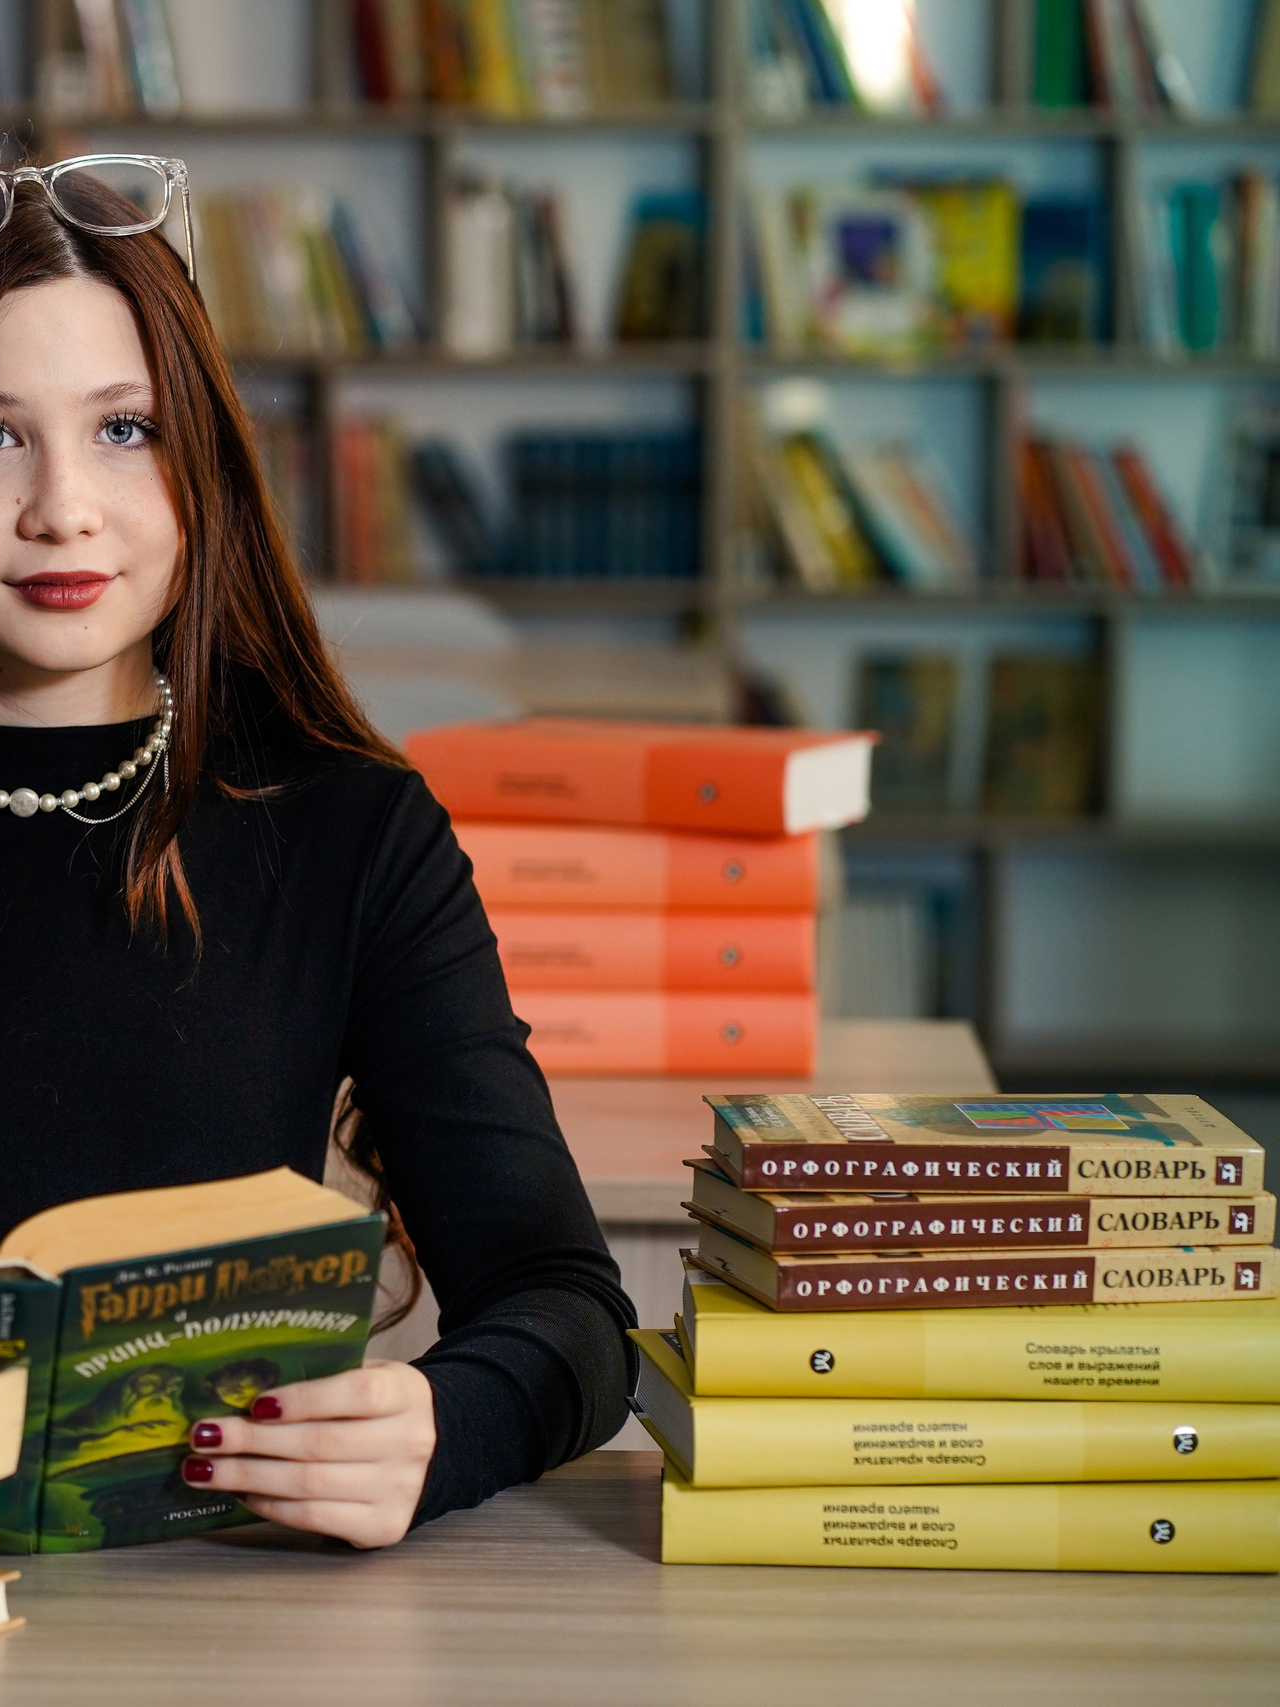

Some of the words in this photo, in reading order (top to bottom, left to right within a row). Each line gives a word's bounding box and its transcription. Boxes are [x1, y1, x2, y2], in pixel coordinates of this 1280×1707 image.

[761, 1158, 1063, 1179] ОРФОГРАФИЧЕСКИЙ
[1077, 1159, 1206, 1180] СЛОВАРЬ
[792, 1213, 1084, 1239] ОРФОГРАФИЧЕСКИЙ
[1096, 1210, 1220, 1232] СЛОВАРЬ
[796, 1269, 1089, 1297] ОРФОГРАФИЧЕСКИЙ
[1102, 1267, 1226, 1289] СЛОВАРЬ
[80, 1273, 208, 1342] Гарри
[214, 1249, 369, 1307] Поттер
[1025, 1342, 1087, 1357] Словарь
[1089, 1345, 1161, 1357] крылатых
[1028, 1361, 1062, 1371] слов
[1066, 1362, 1075, 1370] и
[1078, 1360, 1161, 1373] выражений
[1043, 1376, 1095, 1385] нашего
[1098, 1377, 1160, 1388] времени
[852, 1421, 914, 1433] времени
[917, 1422, 968, 1432] нашего
[853, 1438, 935, 1451] выражений
[938, 1439, 947, 1448] и
[950, 1438, 984, 1448] слов
[853, 1453, 923, 1465] крылатых
[926, 1453, 987, 1467] Словарь
[822, 1502, 884, 1514] времени
[888, 1504, 940, 1515] нашего
[823, 1519, 906, 1532] выражений
[909, 1521, 918, 1531] и
[922, 1522, 955, 1532] слов
[823, 1535, 894, 1546] крылатых
[897, 1536, 958, 1550] Словарь
